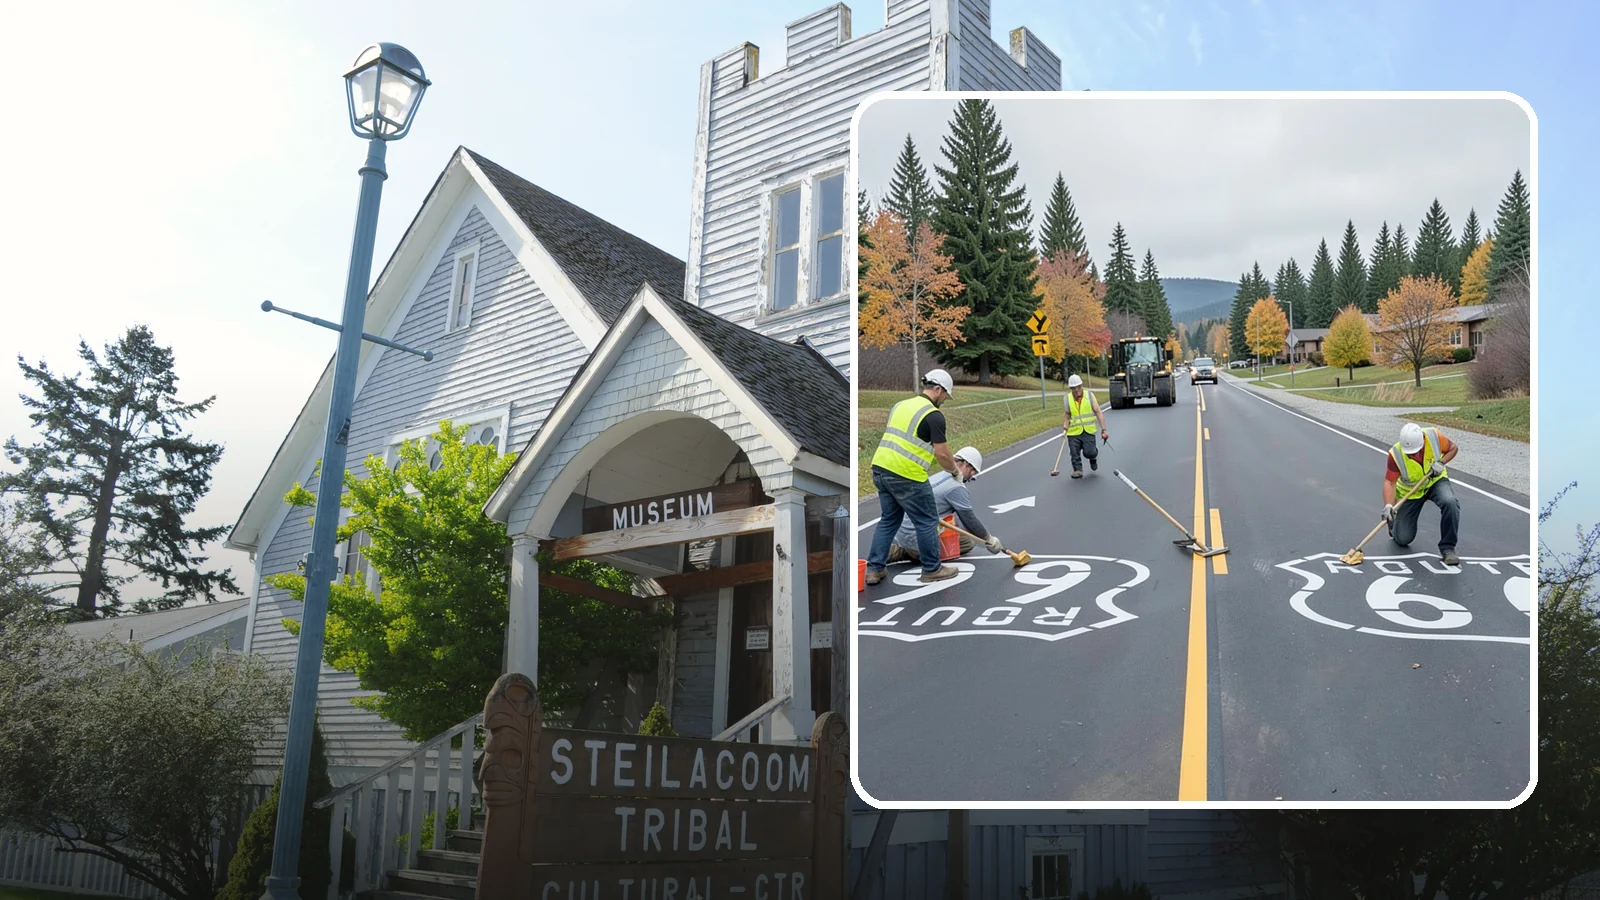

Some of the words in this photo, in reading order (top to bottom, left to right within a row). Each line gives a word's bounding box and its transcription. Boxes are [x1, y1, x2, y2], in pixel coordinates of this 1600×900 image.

[613, 491, 714, 530] MUSEUM
[858, 606, 1082, 626] ROUT
[550, 737, 810, 793] STEILACOOM
[614, 806, 758, 852] TRIBAL
[755, 872, 805, 900] CTR
